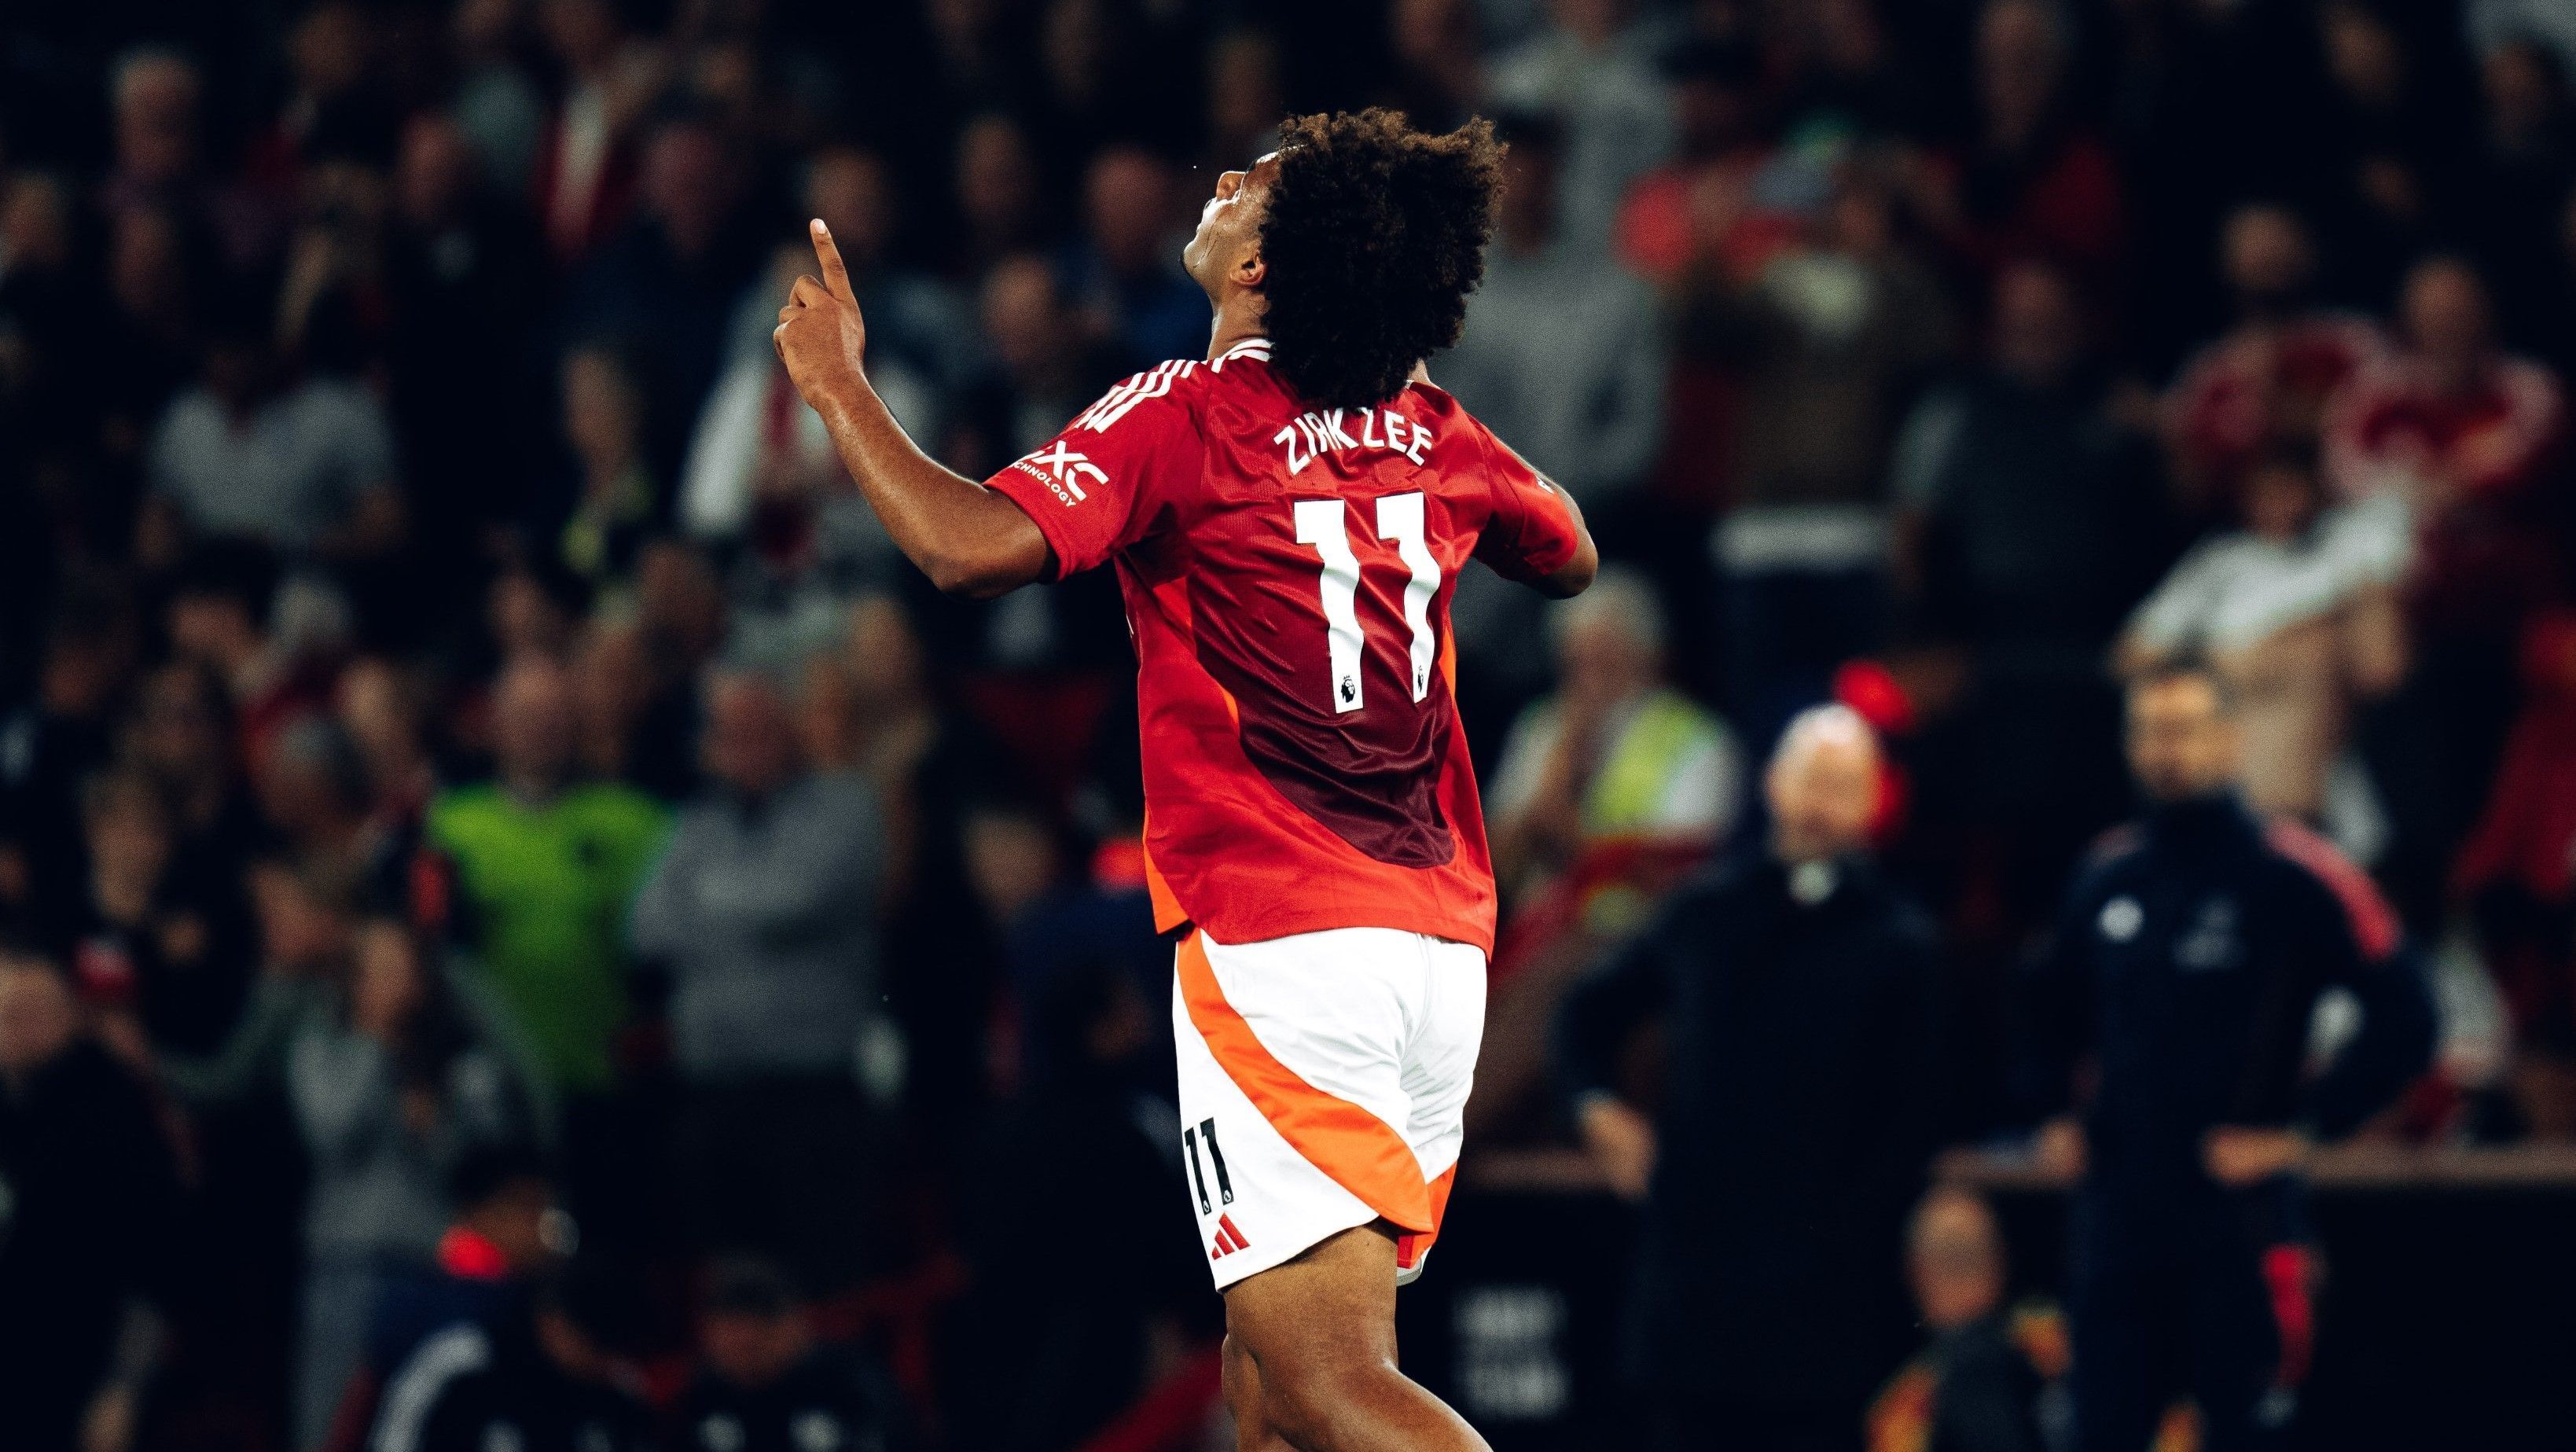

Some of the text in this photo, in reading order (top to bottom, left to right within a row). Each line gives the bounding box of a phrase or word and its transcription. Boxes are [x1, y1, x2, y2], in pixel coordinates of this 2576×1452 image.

[1009, 459, 1077, 508] CHNOLOGY
[1273, 406, 1434, 476] ZIRKZEE
[1293, 491, 1442, 714] 11
[1184, 1116, 1235, 1216] 11
